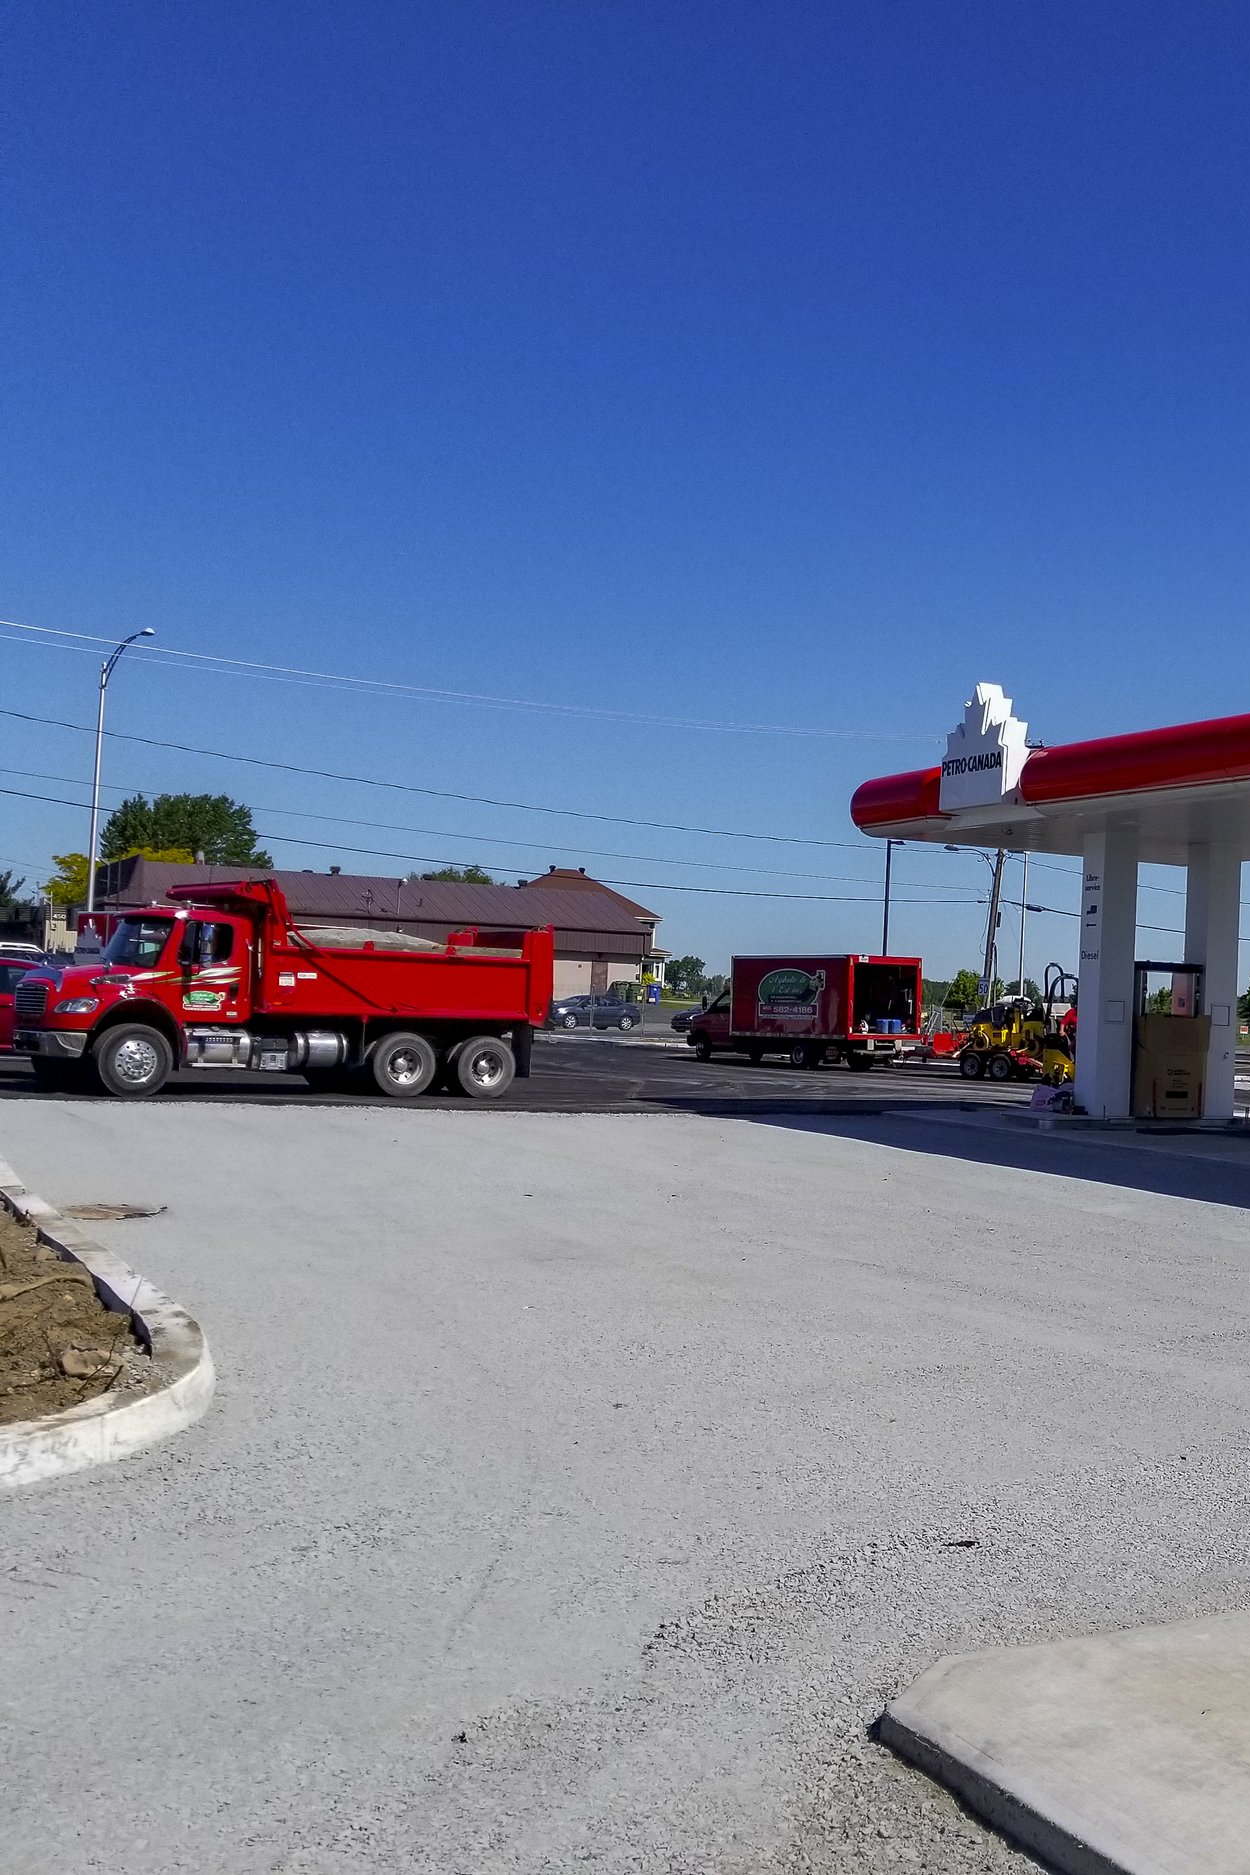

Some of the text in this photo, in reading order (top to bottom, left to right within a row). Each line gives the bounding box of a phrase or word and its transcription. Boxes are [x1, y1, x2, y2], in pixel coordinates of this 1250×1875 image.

[1081, 951, 1100, 960] Diesel
[979, 984, 989, 994] 50
[773, 1006, 813, 1014] 582-4186
